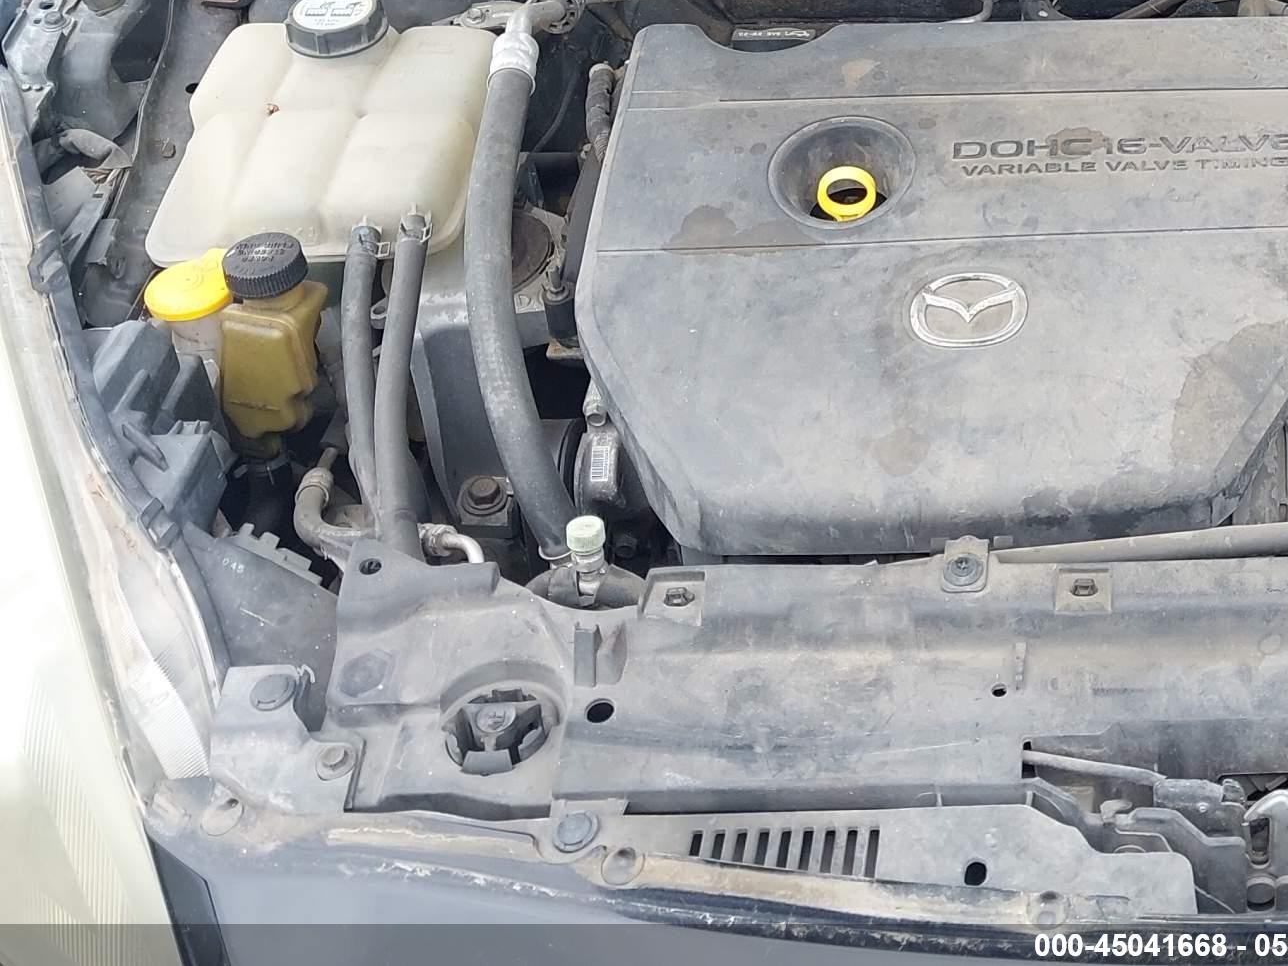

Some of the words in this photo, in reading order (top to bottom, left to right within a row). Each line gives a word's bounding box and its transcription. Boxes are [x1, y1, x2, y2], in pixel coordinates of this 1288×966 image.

[951, 136, 1093, 160] DOHC
[961, 160, 1098, 178] VARIABLE
[1104, 158, 1190, 173] VALVE
